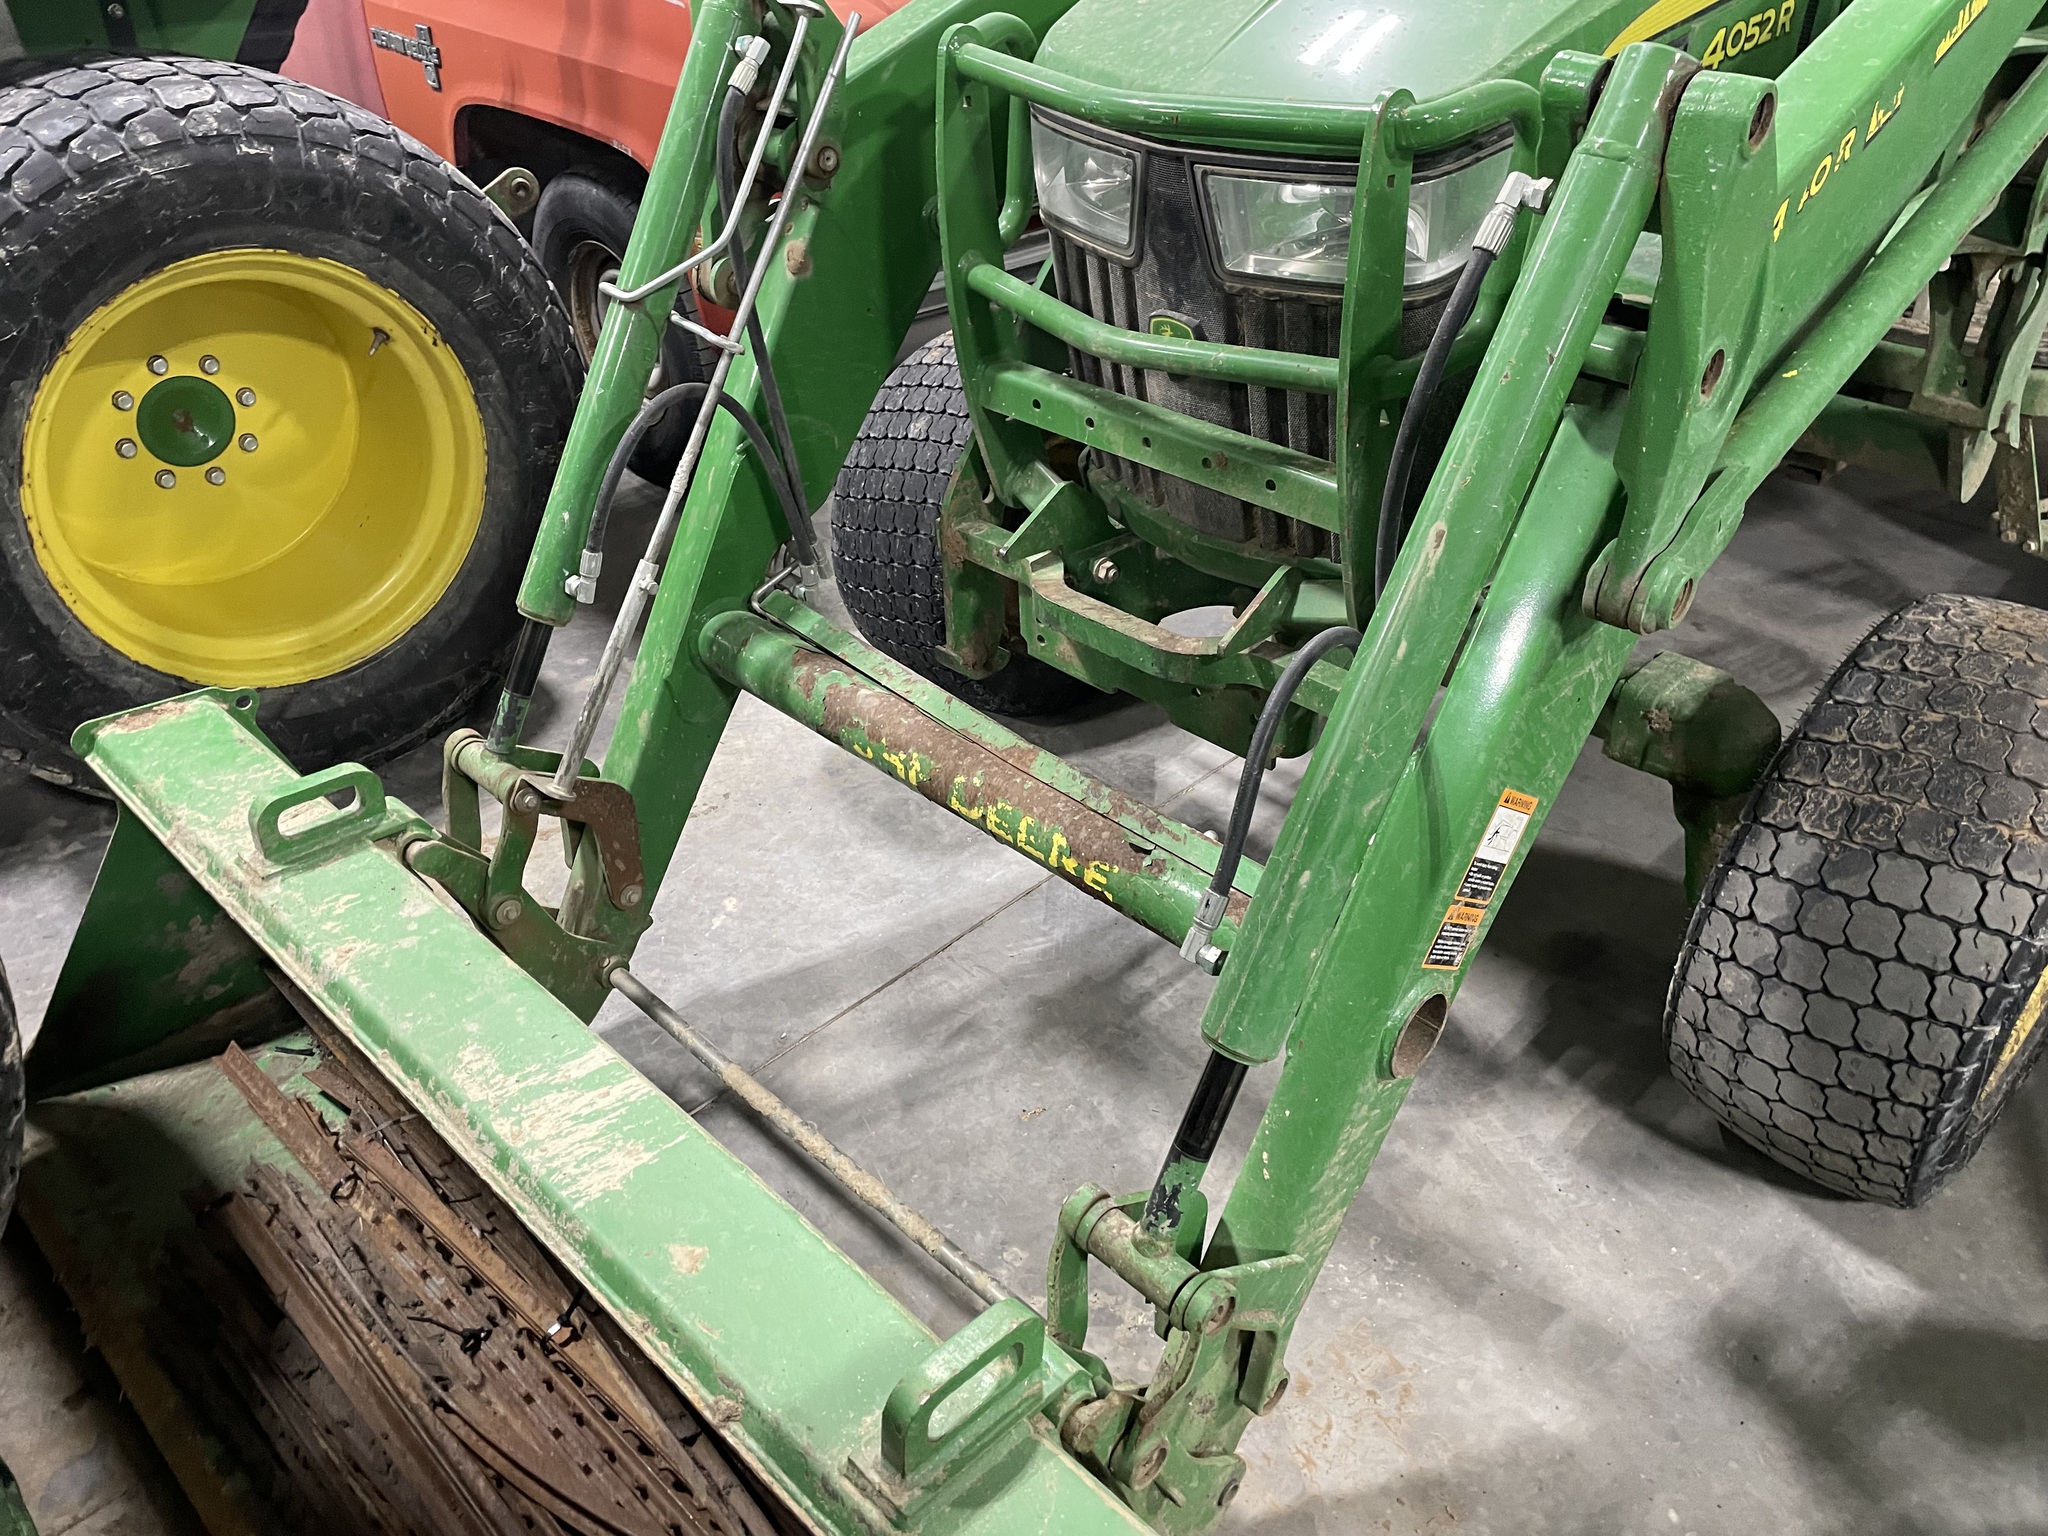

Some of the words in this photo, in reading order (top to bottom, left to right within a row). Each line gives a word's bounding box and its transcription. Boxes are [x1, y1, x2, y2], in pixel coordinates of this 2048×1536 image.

[1701, 0, 1796, 71] 4052R
[1509, 798, 1533, 812] WARNING
[1455, 911, 1480, 923] WARNING
